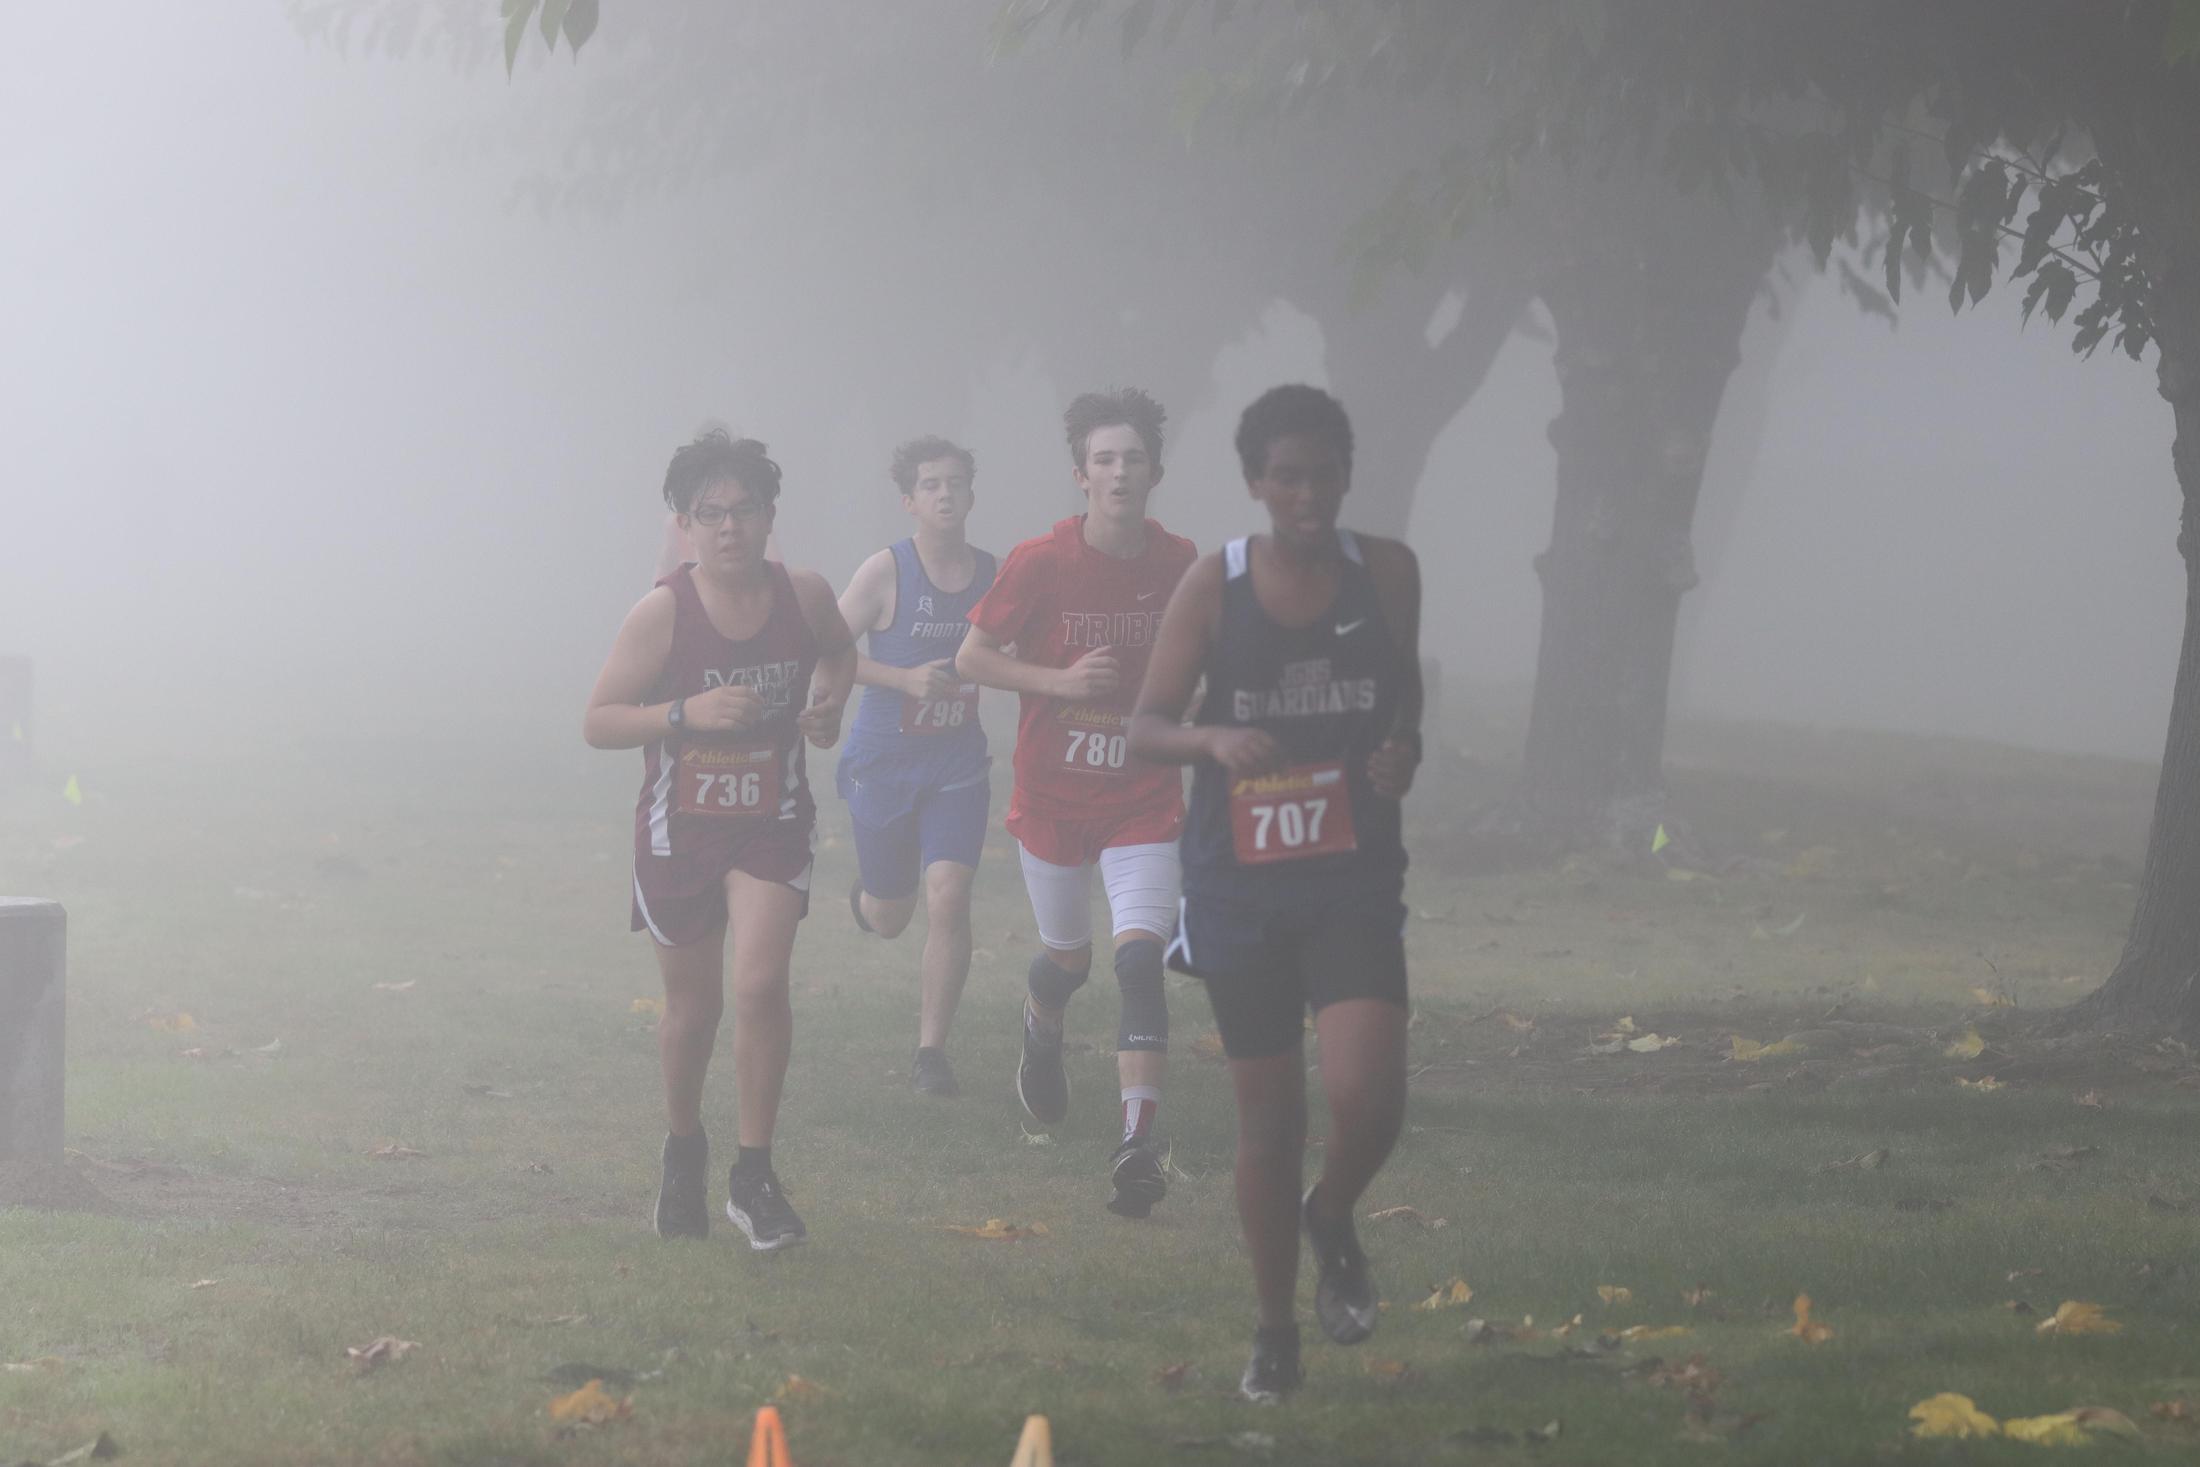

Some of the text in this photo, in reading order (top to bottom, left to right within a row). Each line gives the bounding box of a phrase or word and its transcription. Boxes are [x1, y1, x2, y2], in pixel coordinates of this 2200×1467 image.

[914, 699, 966, 727] 798
[1234, 678, 1376, 721] GUARDIANS
[1065, 729, 1127, 768] 780
[696, 772, 760, 807] 736
[1250, 798, 1328, 850] 707
